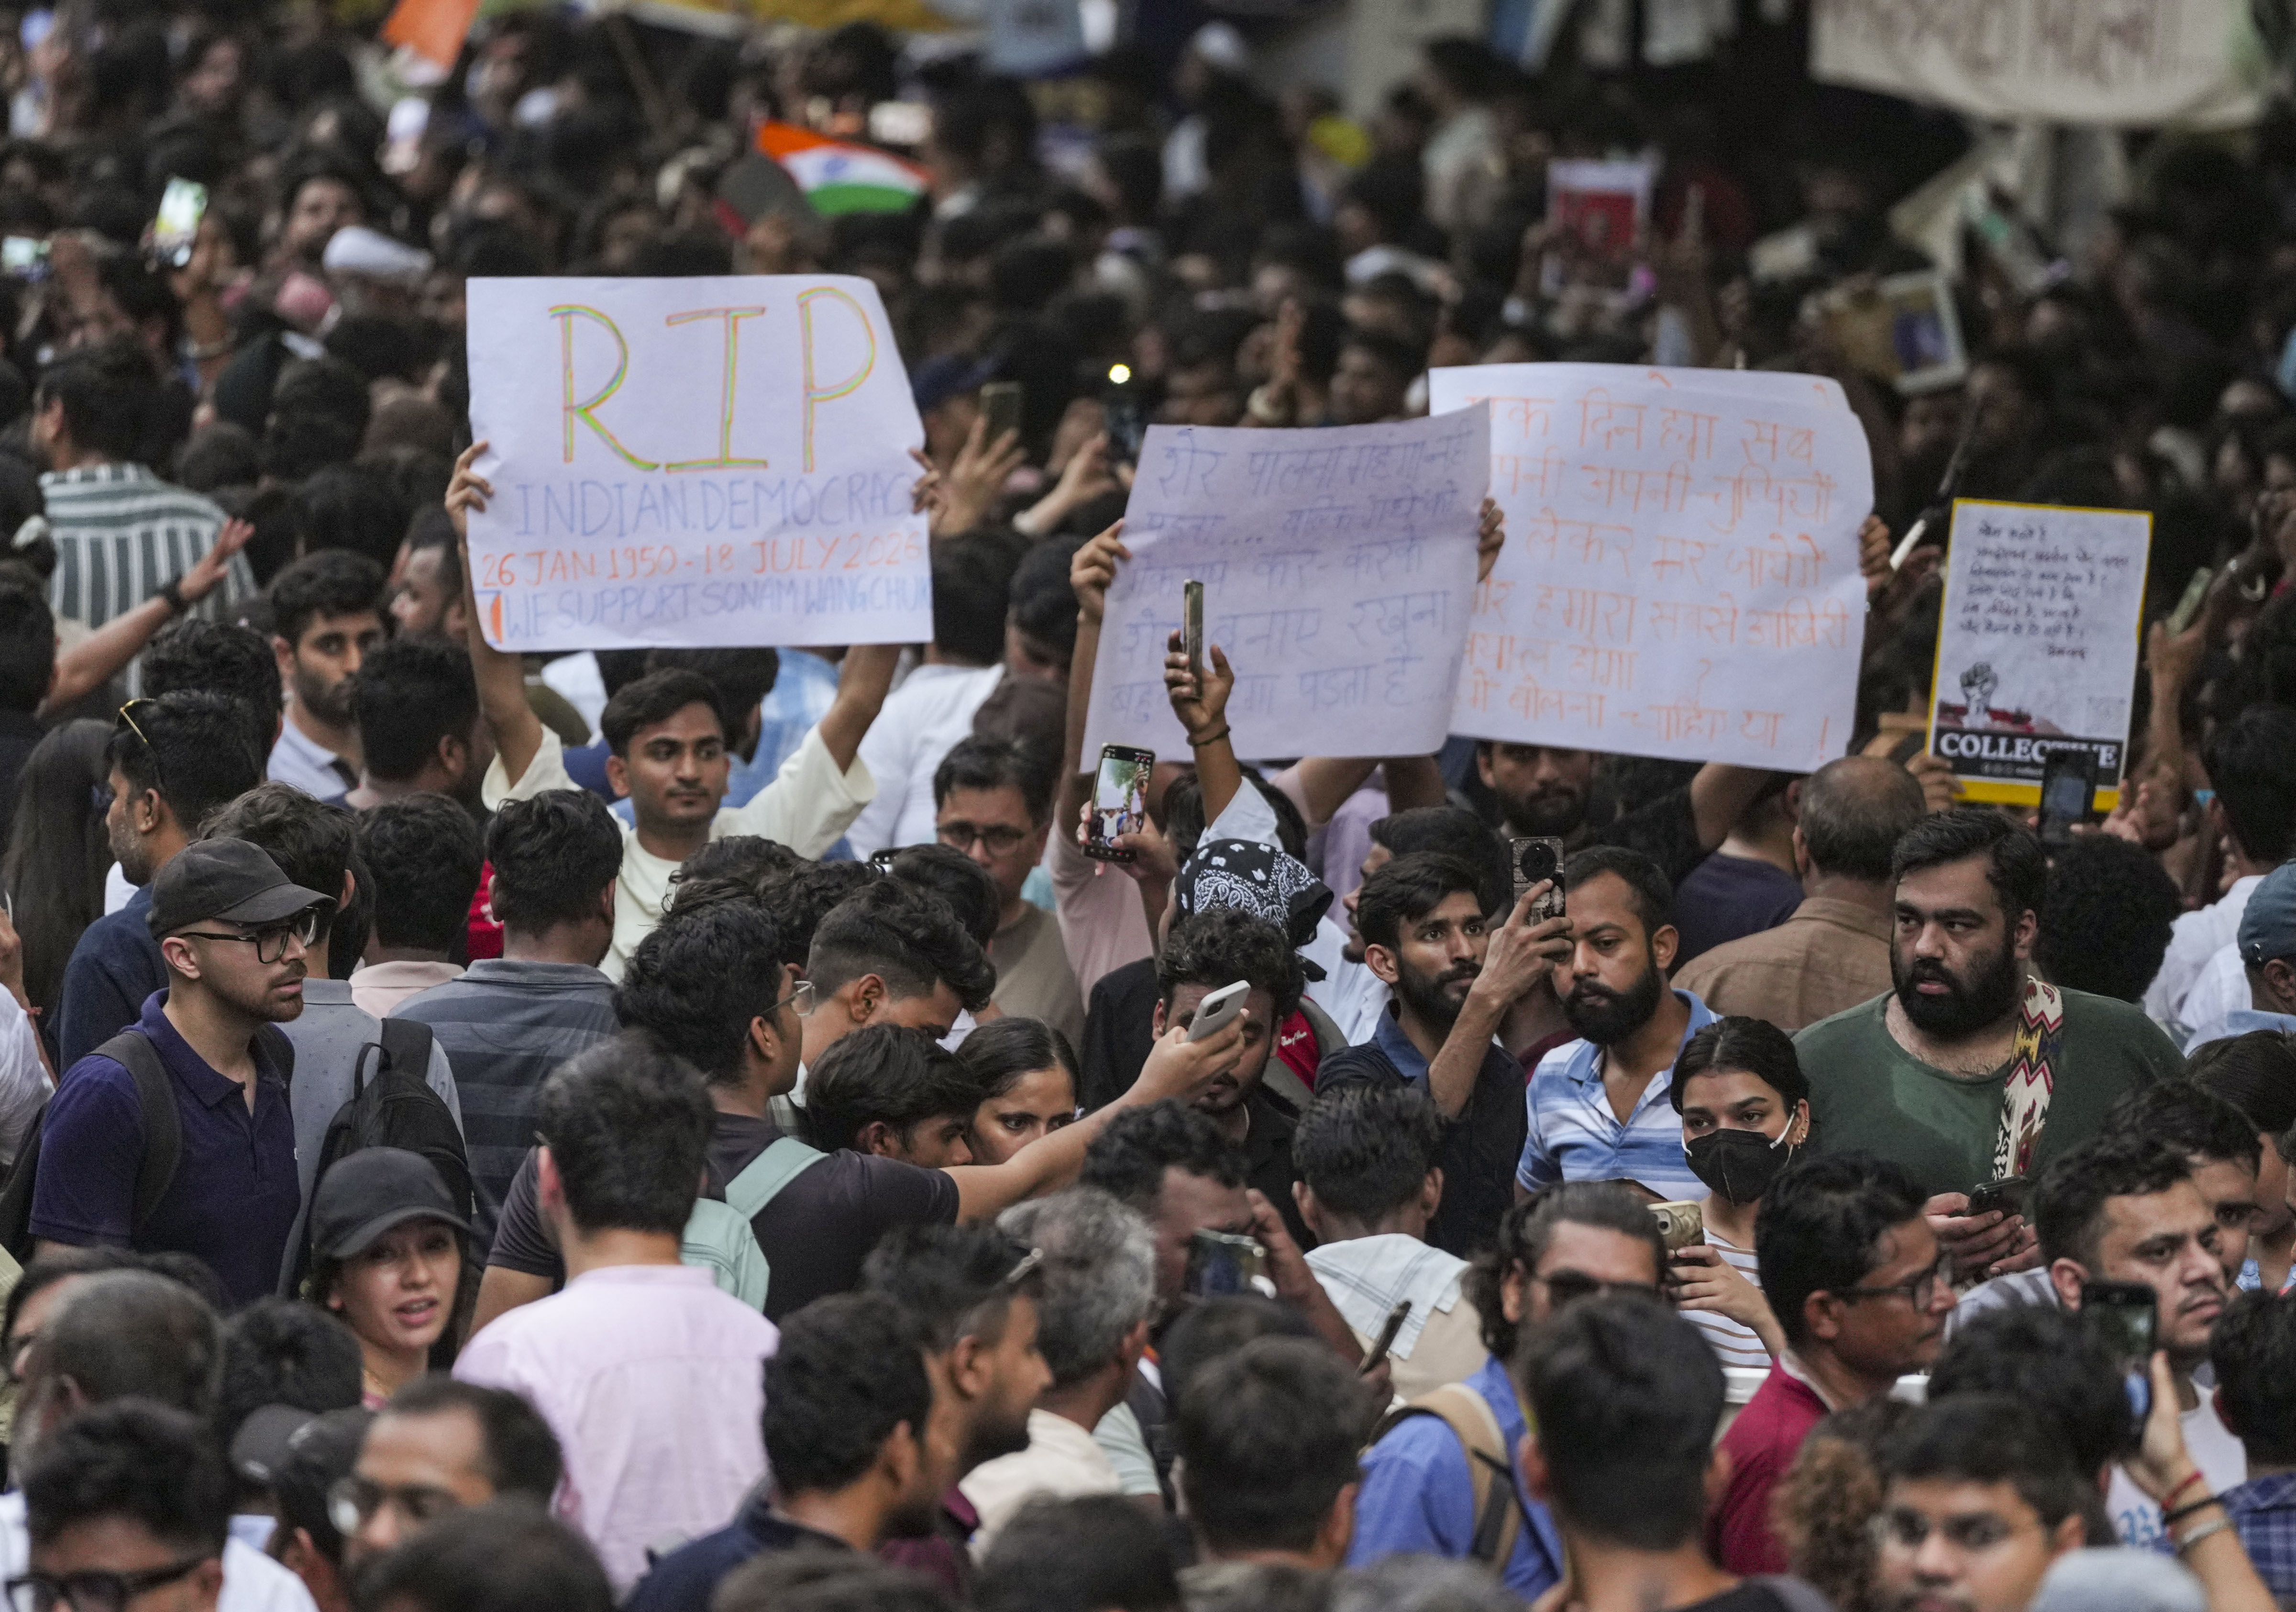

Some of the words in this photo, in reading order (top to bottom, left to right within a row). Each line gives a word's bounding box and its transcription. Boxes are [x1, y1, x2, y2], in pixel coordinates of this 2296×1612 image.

[548, 286, 876, 473] RIP
[1576, 387, 1648, 451] दिन
[1740, 415, 1818, 467] सब
[700, 471, 907, 532] DEMOCRAC
[1489, 444, 1570, 499] पनी
[1580, 458, 1694, 513] अपनी
[482, 551, 517, 587] 26
[525, 549, 596, 586] JAN
[607, 543, 678, 580] 1950
[704, 543, 735, 574] 18
[751, 537, 841, 574] JULY
[842, 530, 923, 569] 2026
[557, 581, 696, 628] SUPPORT
[700, 578, 798, 617] SONAM
[1110, 678, 1167, 723] बहु
[1939, 732, 2118, 769] COLLECE
